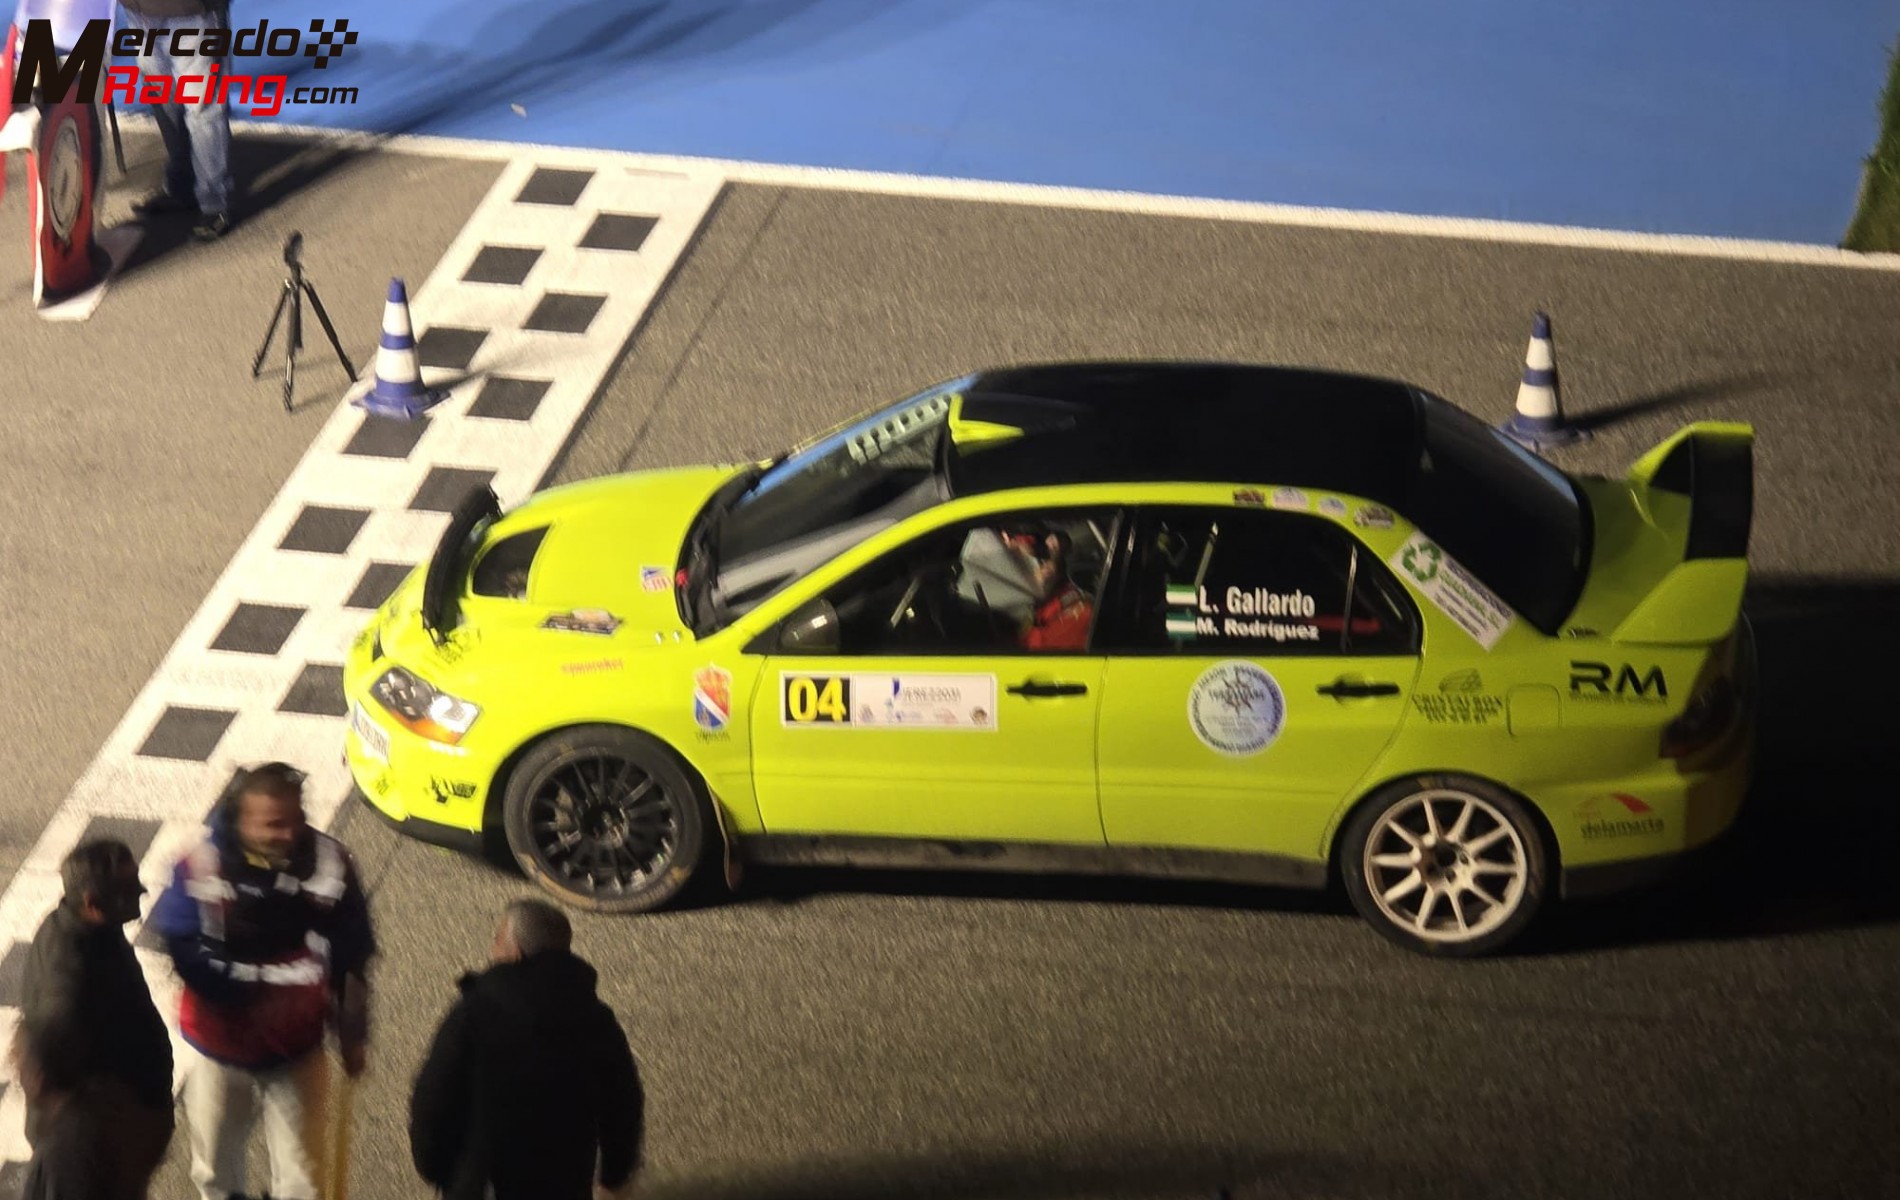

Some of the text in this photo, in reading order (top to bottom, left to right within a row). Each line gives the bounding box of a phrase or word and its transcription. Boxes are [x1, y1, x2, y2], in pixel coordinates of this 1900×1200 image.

[1199, 585, 1316, 617] L. Gallardo
[1196, 616, 1220, 636] M.
[1569, 659, 1668, 697] RM
[788, 677, 846, 722] 04
